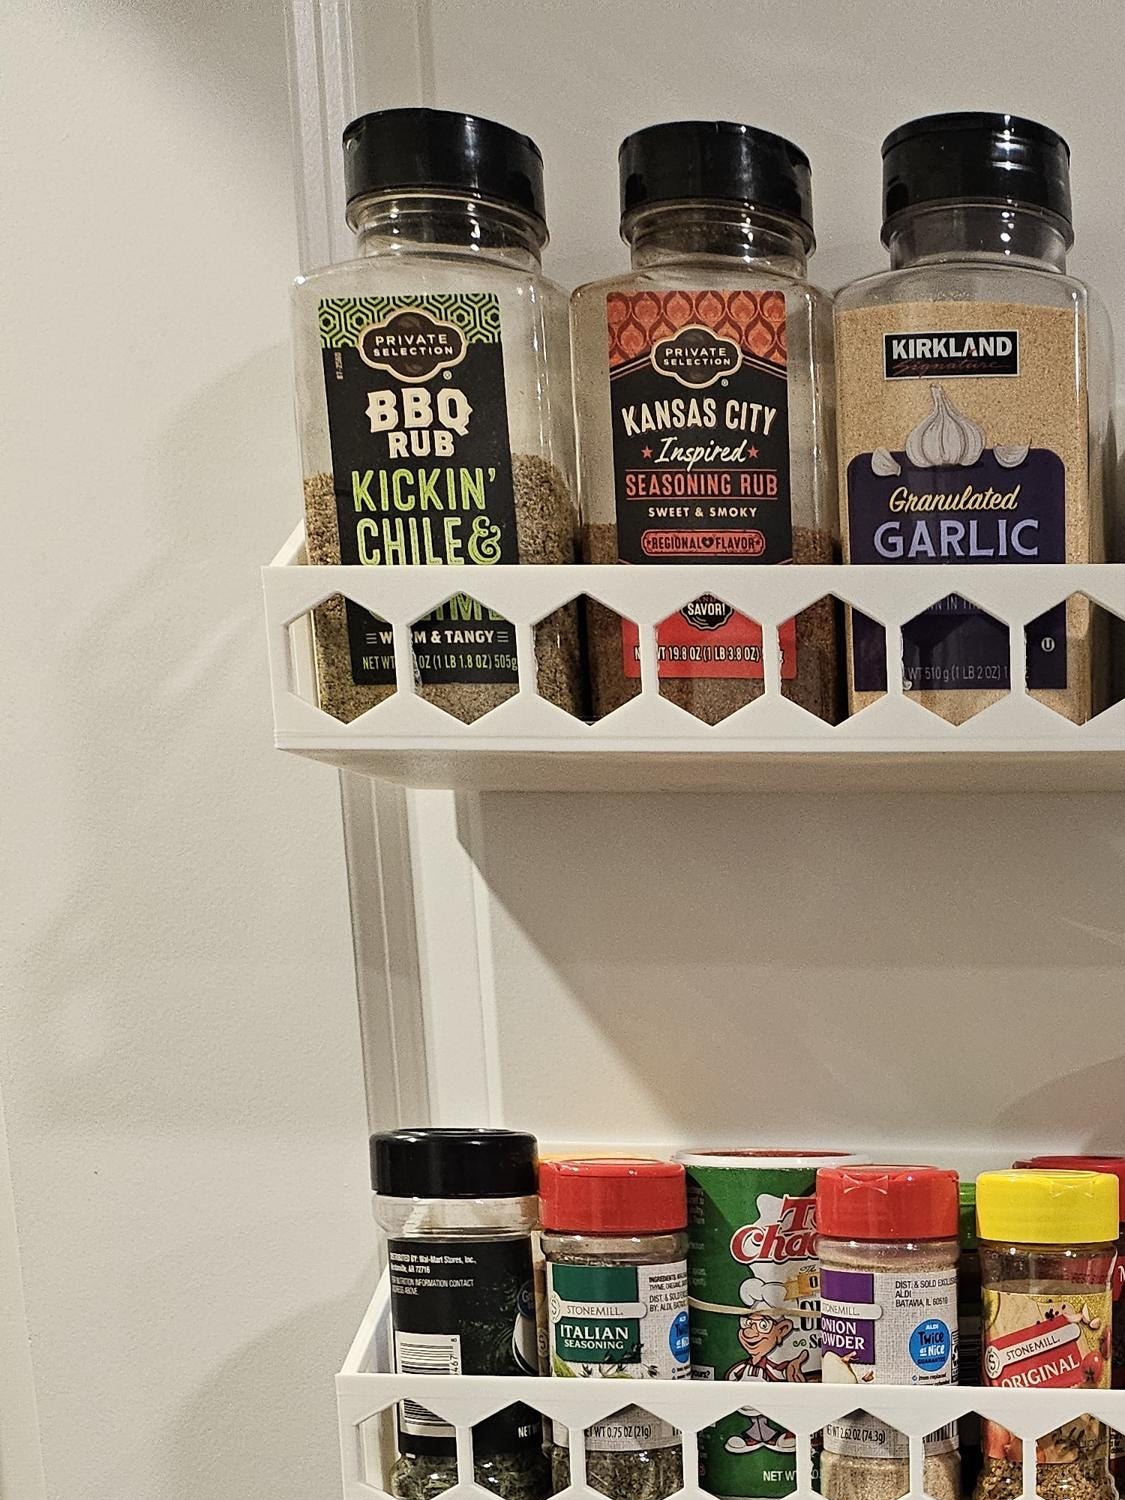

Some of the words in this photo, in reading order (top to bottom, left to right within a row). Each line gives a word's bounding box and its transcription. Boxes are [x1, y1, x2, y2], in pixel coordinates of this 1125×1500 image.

[375, 334, 447, 346] PRIVATE
[373, 346, 454, 357] SELECTION
[665, 348, 726, 358] PRIVATE
[892, 336, 1012, 360] KIRKLAND
[663, 357, 731, 366] SELECTION
[892, 359, 1010, 377] Signature
[365, 388, 473, 436] BBQ
[621, 397, 716, 436] KANSAS
[725, 399, 777, 436] CITY
[388, 430, 455, 459] RUB
[654, 437, 746, 472] Inspired
[351, 468, 496, 513] KICKIN'
[626, 474, 732, 496] SEASONING
[740, 474, 778, 496] RUB
[889, 484, 1020, 513] Granulated
[648, 507, 690, 518] SWEET
[695, 507, 703, 517] &
[709, 507, 758, 518] SMOKY
[651, 536, 701, 550] REGIONAL
[715, 536, 755, 550] FLAVOR
[873, 519, 1039, 559] GARLIC
[687, 603, 725, 617] SAVOR!
[430, 631, 441, 643] &
[445, 631, 494, 643] TANGY
[363, 657, 380, 670] NET
[449, 1279, 474, 1287] CONTACT
[895, 1289, 912, 1298] ALDI
[567, 1306, 620, 1315] STONEMILL
[561, 1325, 628, 1340] ITALIAN
[821, 1320, 856, 1334] ONION
[565, 1340, 624, 1349] SEASONING
[823, 1336, 865, 1350] OWDER
[918, 1331, 944, 1344] Twice
[928, 1345, 944, 1355] Nice
[1006, 1338, 1060, 1361] STONEMILL
[1002, 1356, 1080, 1387] ORIGINAL
[862, 1430, 885, 1443] (74.3g)
[763, 1472, 782, 1481] NET
